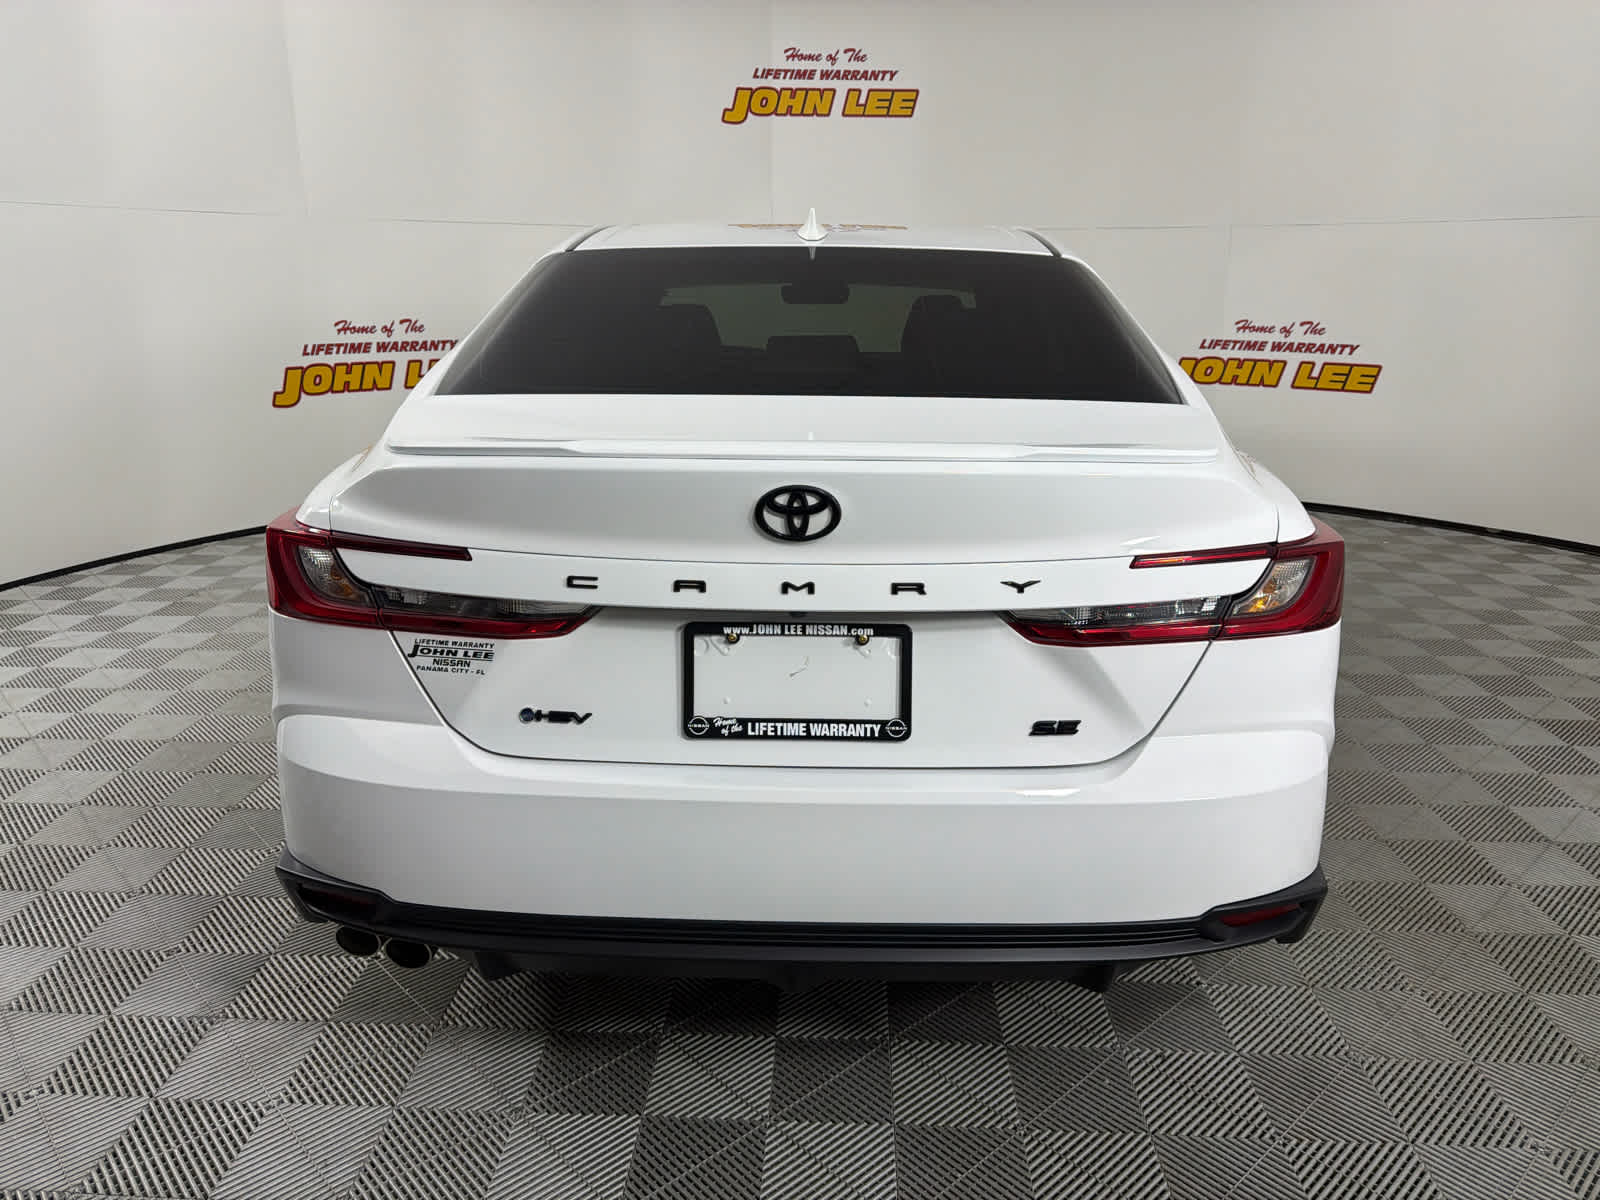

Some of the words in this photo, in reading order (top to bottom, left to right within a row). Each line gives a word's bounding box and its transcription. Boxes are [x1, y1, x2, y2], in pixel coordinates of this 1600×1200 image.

[784, 47, 823, 62] Home
[826, 50, 840, 66] of
[843, 48, 868, 62] The
[752, 68, 816, 80] LIFETIME
[819, 69, 899, 81] WARRANTY
[721, 86, 836, 124] JOHN
[842, 88, 919, 118] LEE
[334, 320, 377, 335] Home
[381, 321, 395, 337] of
[399, 318, 425, 334] The
[1235, 319, 1275, 334] Home
[1280, 322, 1295, 338] of
[1300, 321, 1326, 336] The
[302, 342, 373, 356] LIFETIME
[376, 339, 459, 353] WARRANTY
[1199, 338, 1268, 352] LIFETIME
[1270, 341, 1360, 355] WARRANTY
[272, 361, 395, 408] JOHN
[1291, 361, 1382, 394] LEE
[566, 574, 1041, 596] CAMRY
[784, 624, 803, 635] LEE
[414, 638, 449, 646] LIFETIME
[451, 641, 495, 649] WARRANTY
[407, 644, 458, 658] JOHN
[463, 650, 495, 660] LEE
[416, 665, 449, 673] PANAMA
[432, 659, 471, 668] NISSAN
[713, 717, 737, 728] Home
[721, 725, 730, 736] of
[747, 722, 807, 736] LIFETIME
[809, 723, 882, 737] WARRANTY
[1028, 720, 1082, 736] SE
